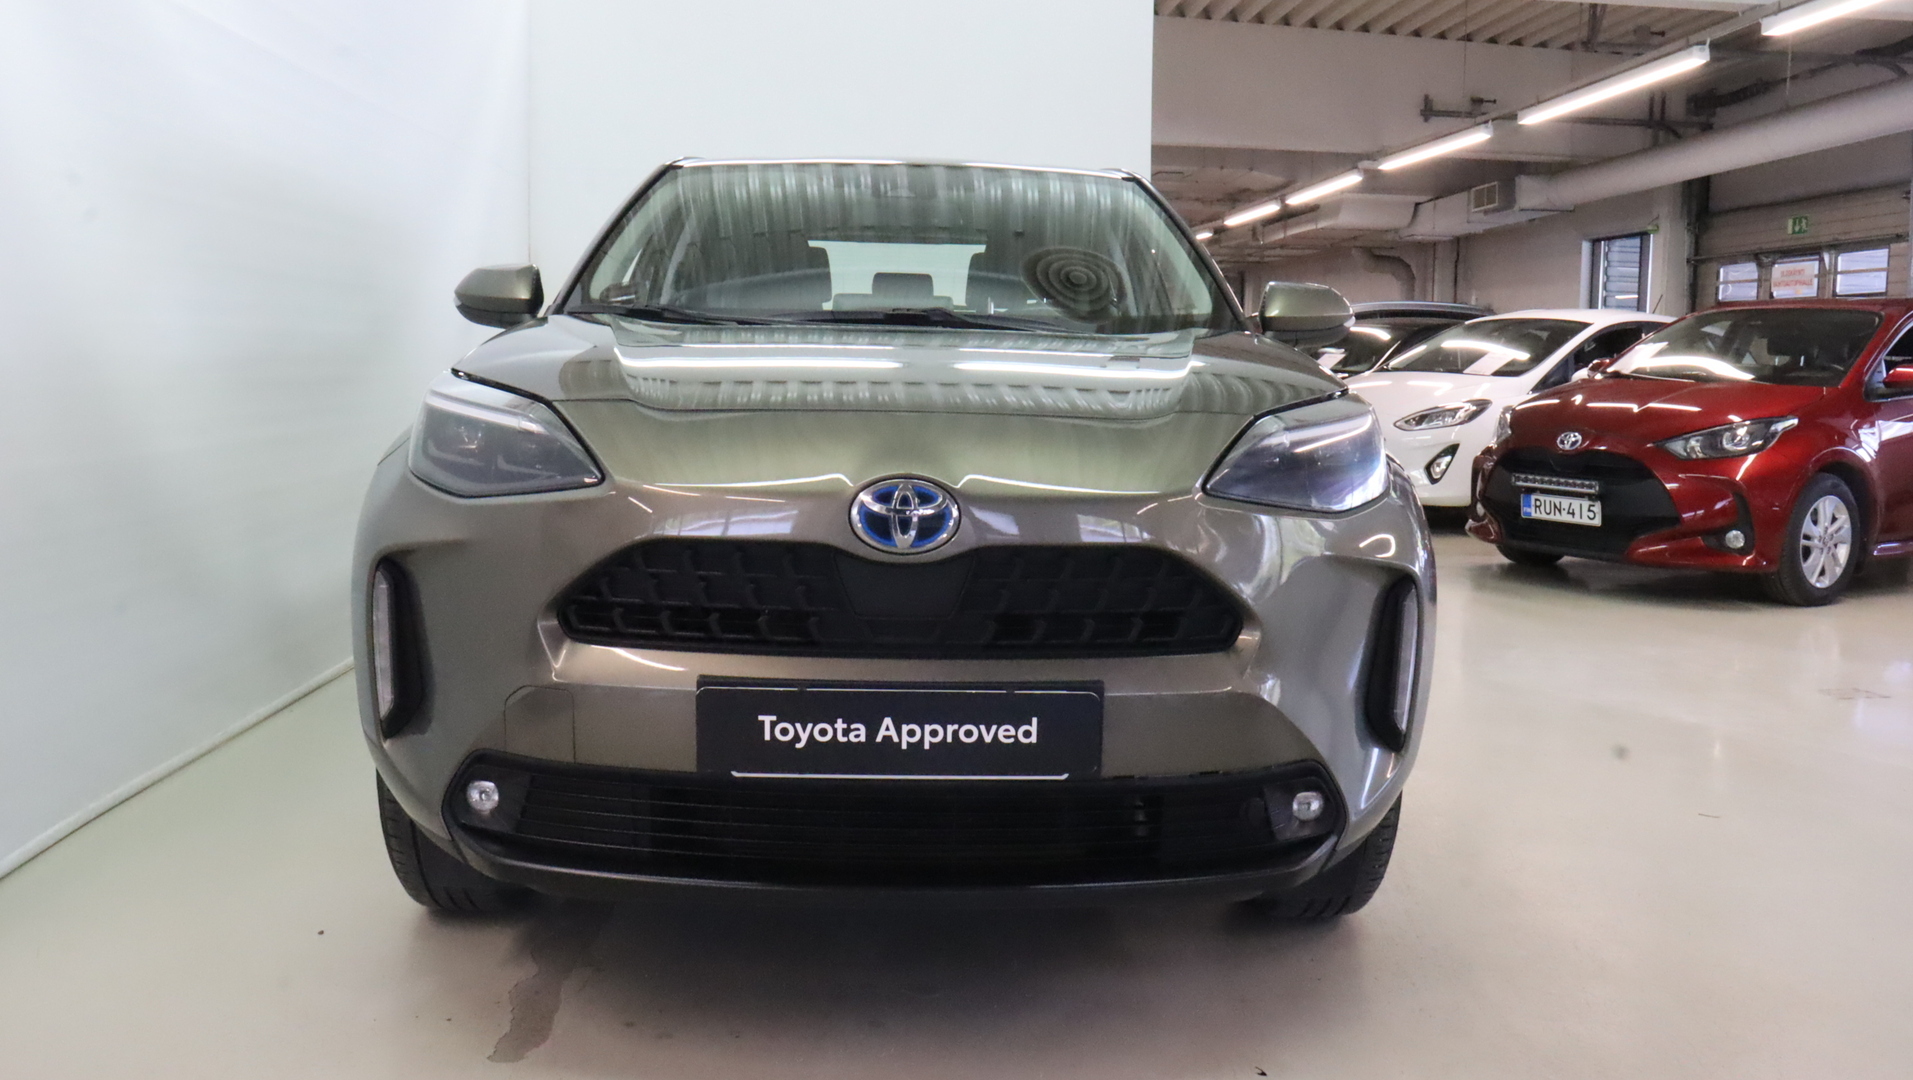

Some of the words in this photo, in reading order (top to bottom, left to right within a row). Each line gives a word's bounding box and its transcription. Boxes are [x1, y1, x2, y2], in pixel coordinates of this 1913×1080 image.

[1534, 498, 1597, 521] RUN-415
[757, 714, 867, 749] Toyota
[875, 716, 1039, 750] Approved
